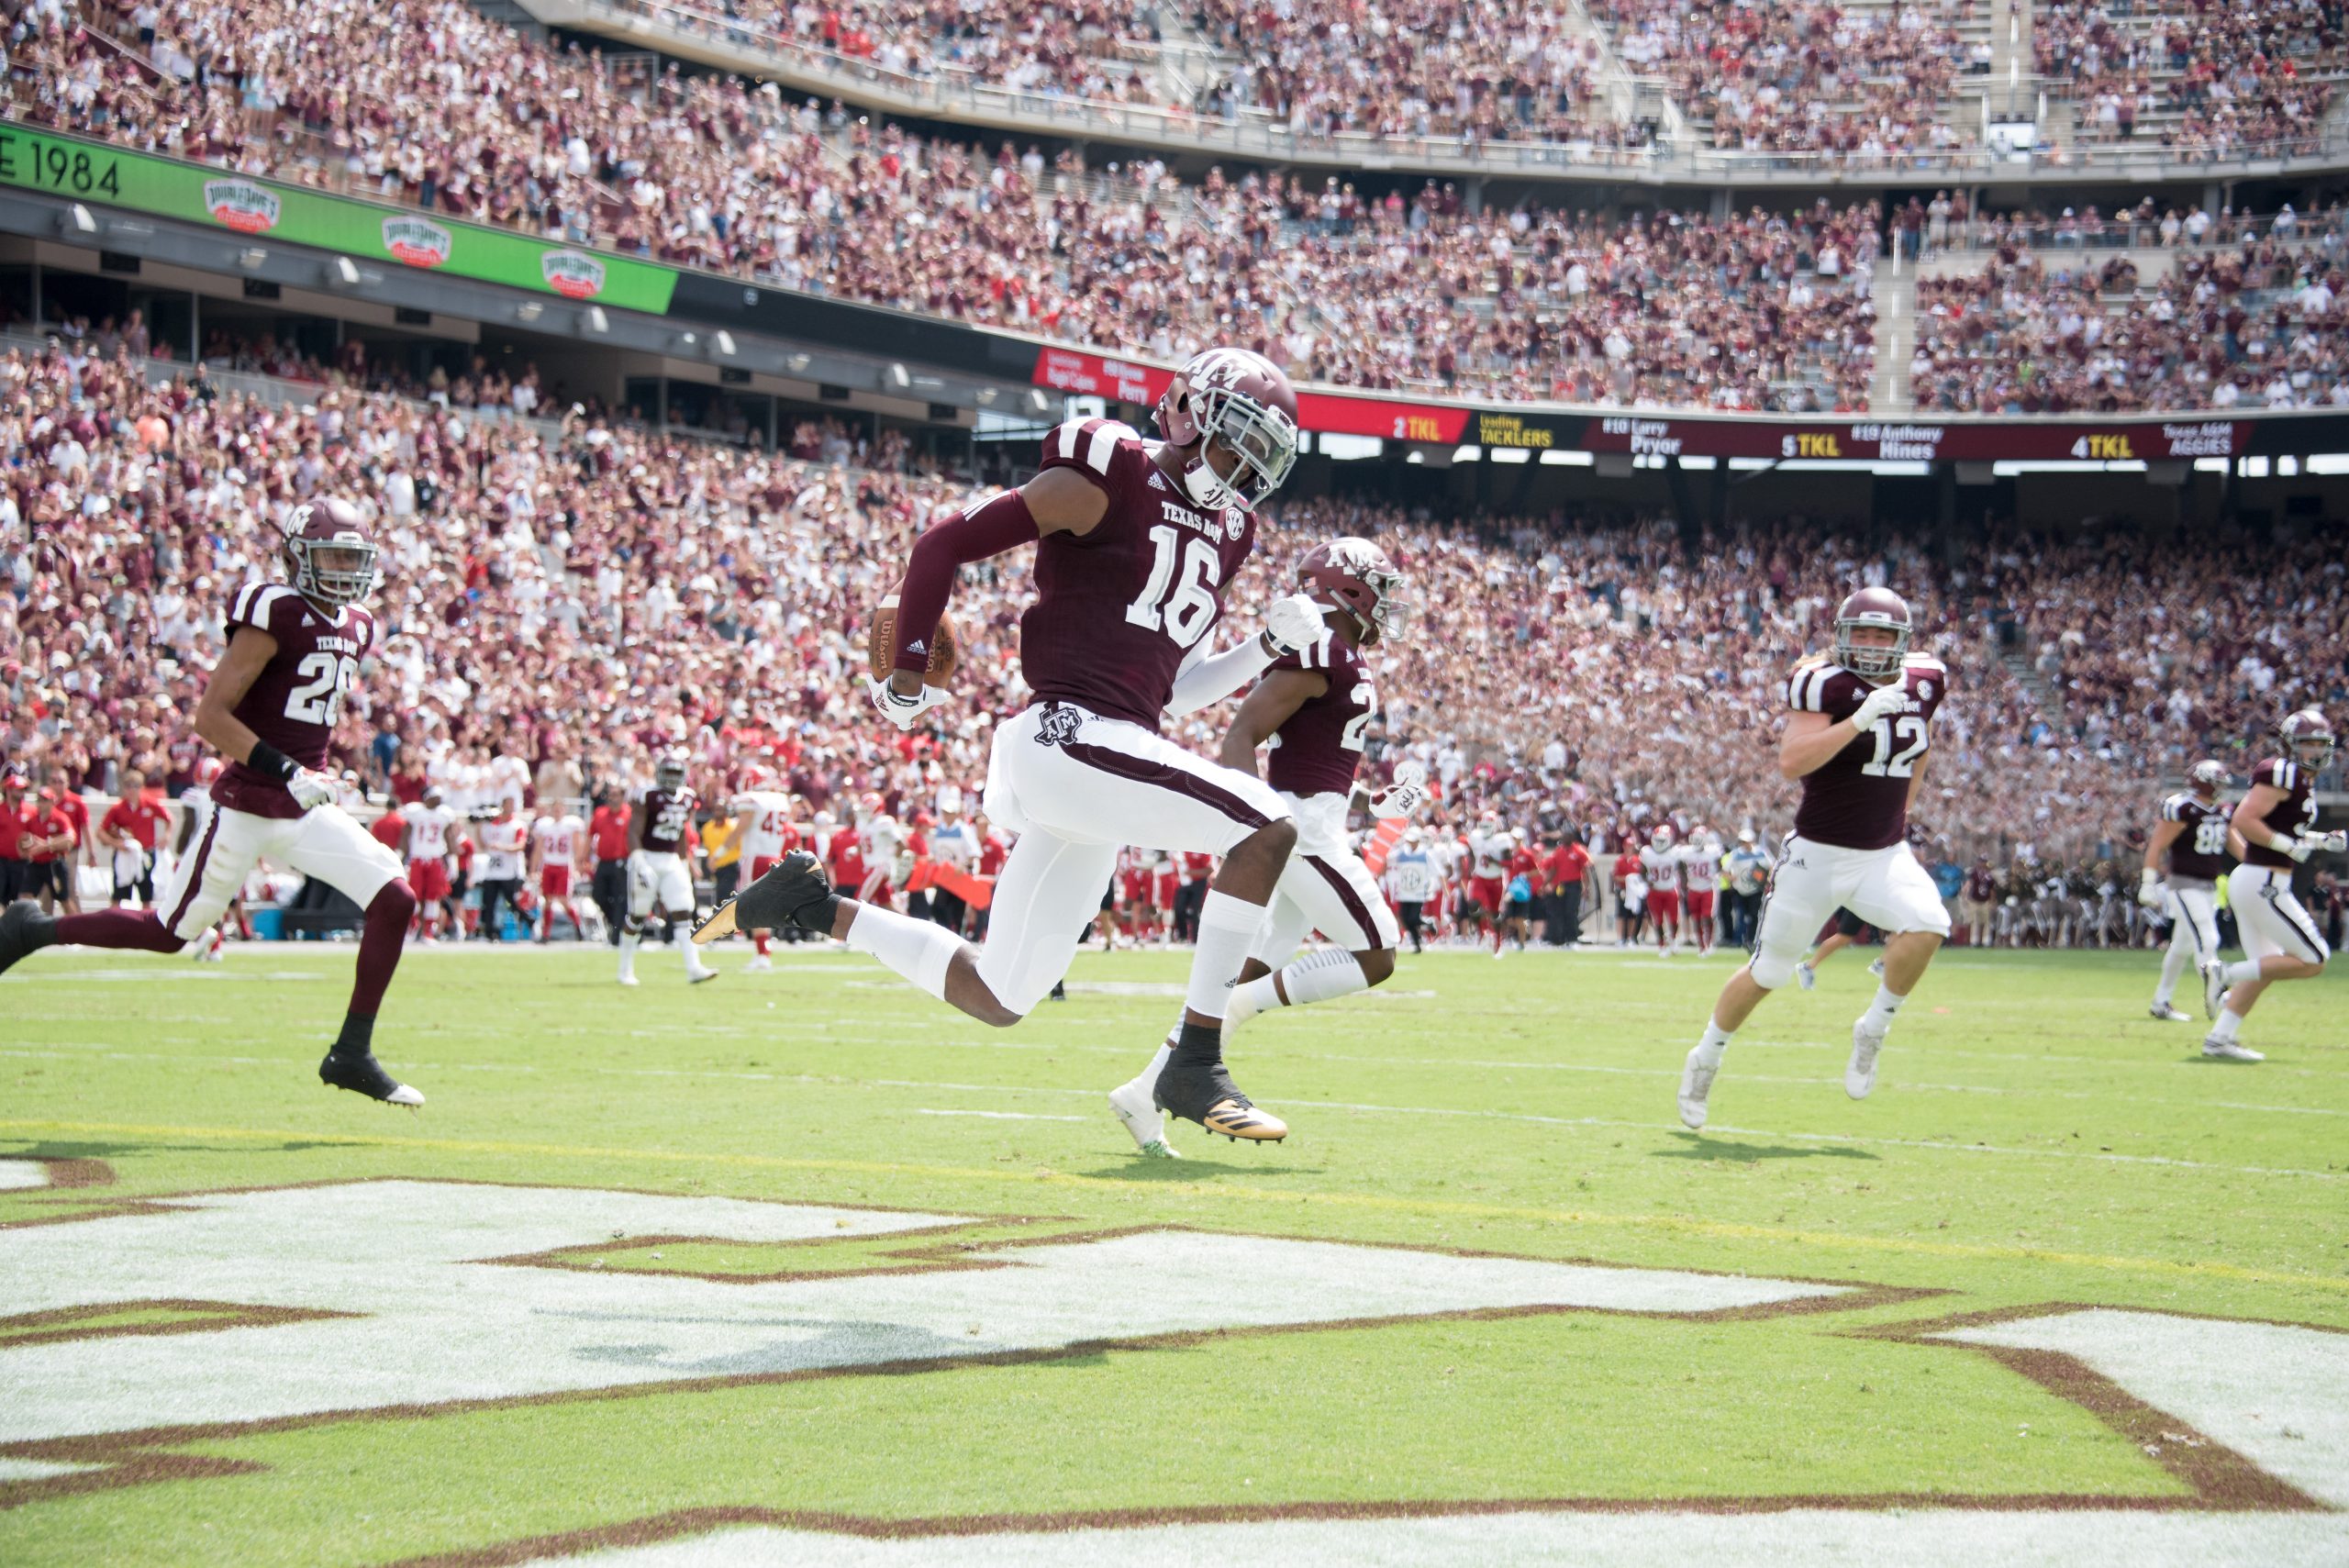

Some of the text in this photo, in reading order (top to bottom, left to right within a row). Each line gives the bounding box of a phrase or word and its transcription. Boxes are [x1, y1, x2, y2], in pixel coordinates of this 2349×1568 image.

[30, 141, 119, 198] 1984
[1394, 417, 1441, 441] 2 TKL
[1480, 428, 1553, 447] TACKLERS
[1881, 425, 1943, 443] Anthony
[1782, 434, 1841, 457] 5 TKL
[2071, 435, 2133, 459] 4 TKL
[1162, 501, 1224, 545] TEXAS A&M
[1228, 511, 1242, 539] SEC
[1125, 525, 1220, 649] 16
[880, 620, 893, 669] Wilson
[1862, 717, 1930, 778] 12
